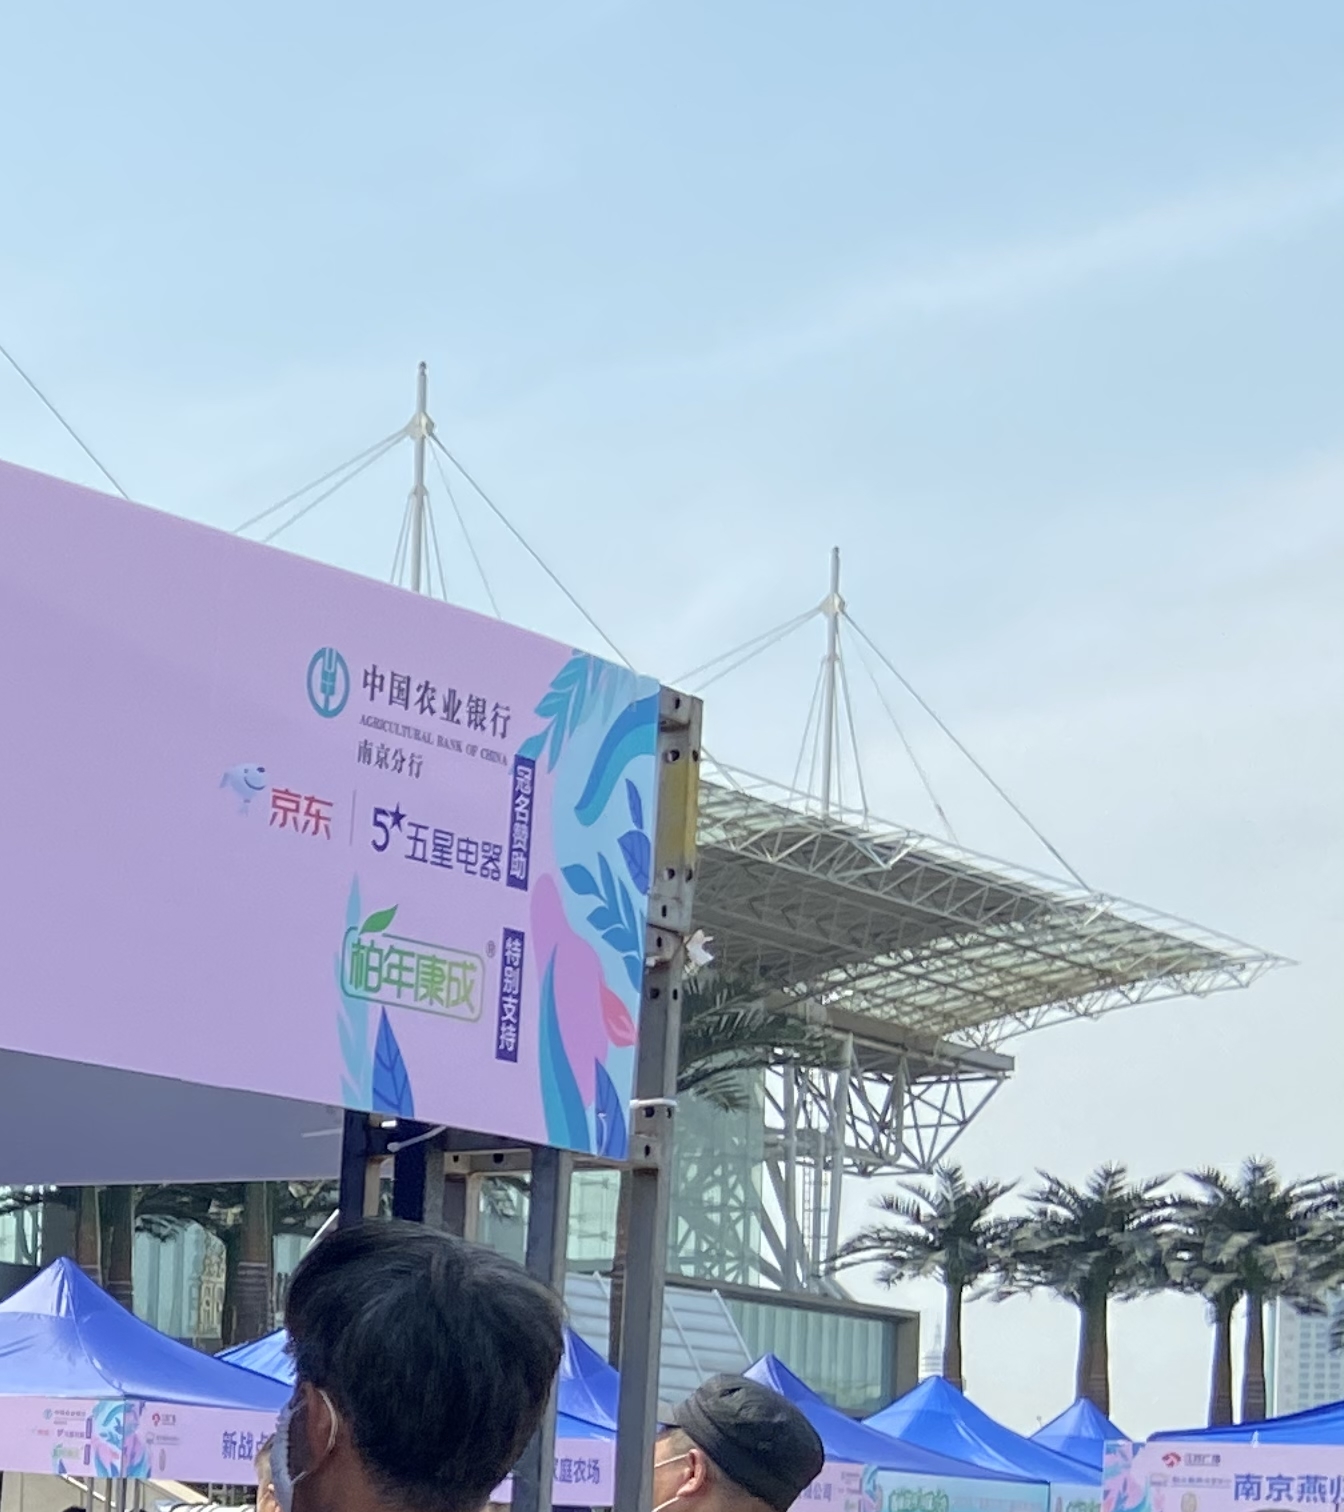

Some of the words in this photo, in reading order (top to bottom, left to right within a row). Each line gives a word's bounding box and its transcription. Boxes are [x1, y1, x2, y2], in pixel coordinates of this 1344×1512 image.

[362, 663, 511, 739] 中国农业银行
[357, 738, 424, 780] 南京分行
[359, 714, 434, 746] AGRICULTURAL
[436, 736, 463, 754] BANK
[465, 744, 479, 758] OF
[480, 747, 508, 767] CHINA
[268, 787, 334, 841] 京东
[404, 821, 503, 882] 五星电器
